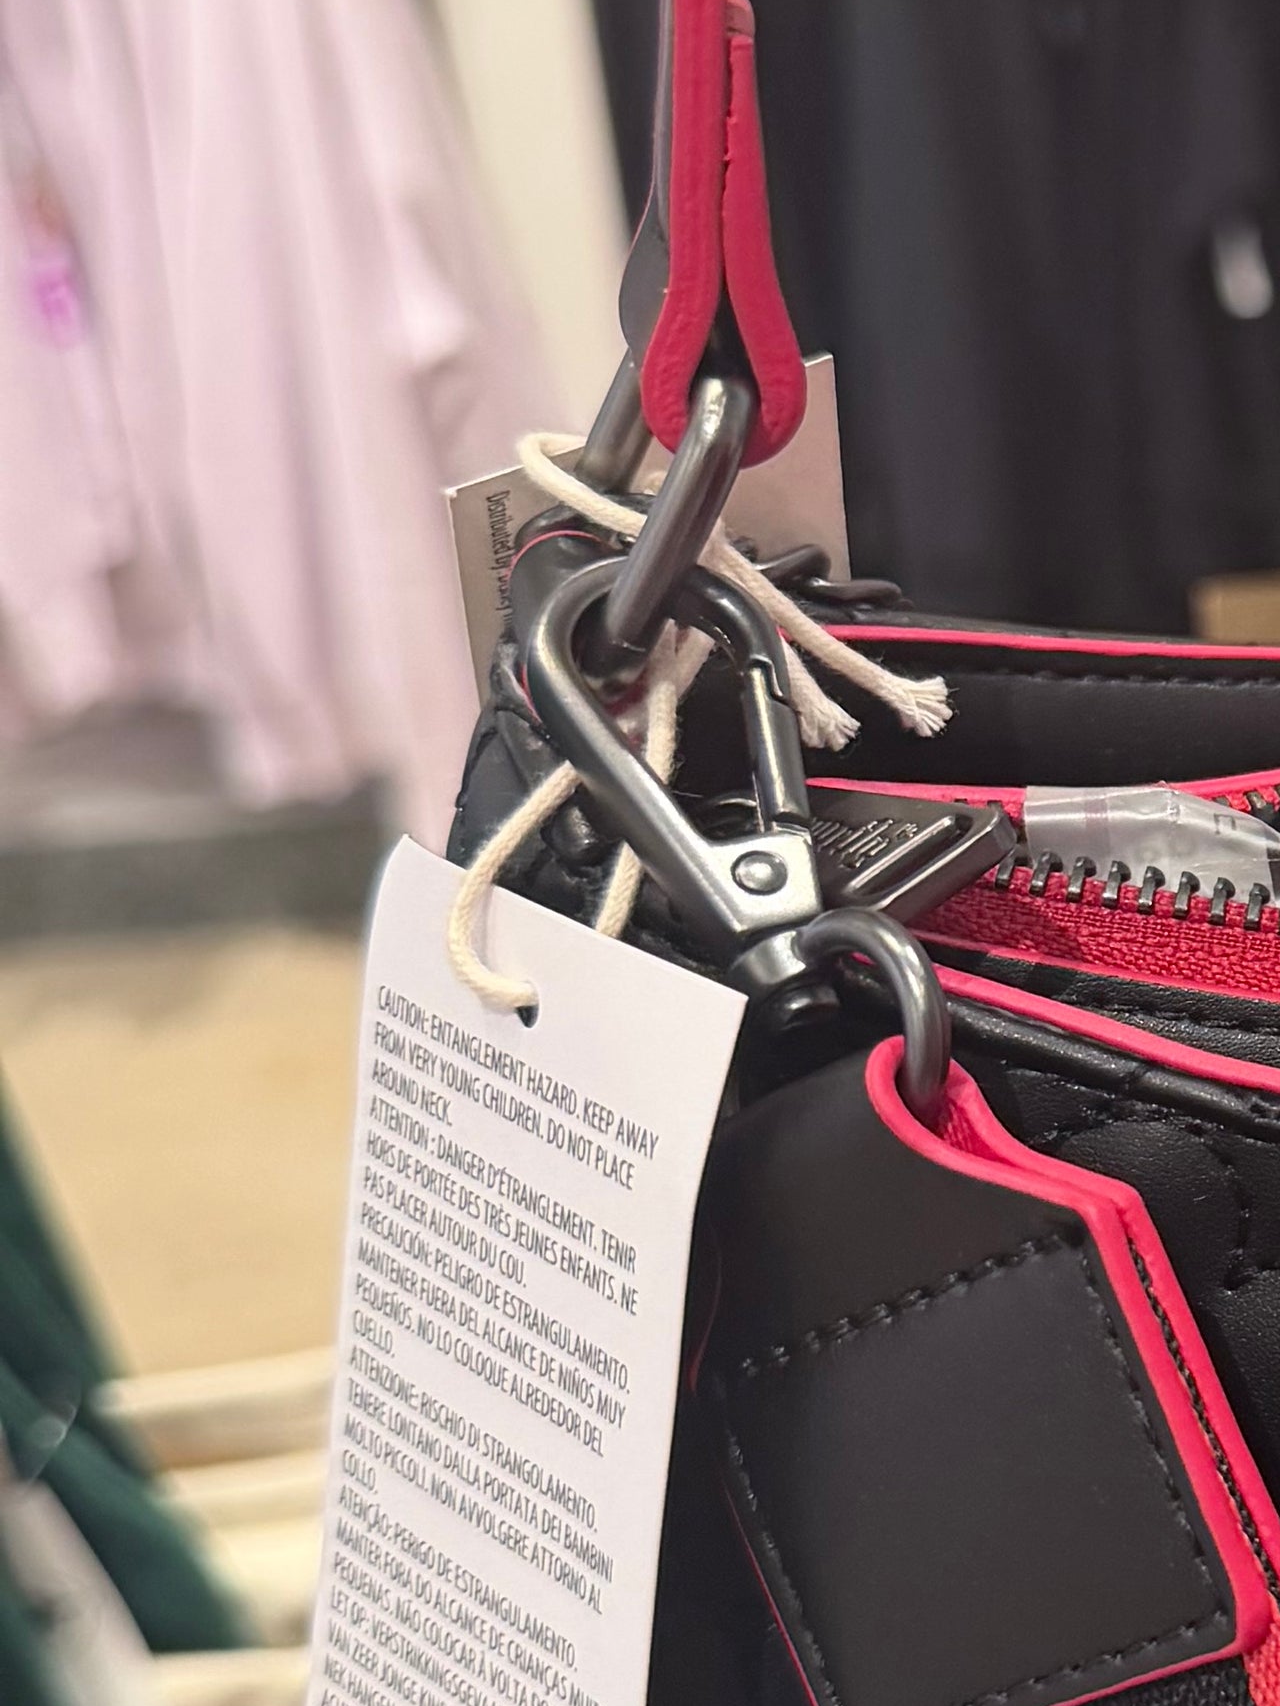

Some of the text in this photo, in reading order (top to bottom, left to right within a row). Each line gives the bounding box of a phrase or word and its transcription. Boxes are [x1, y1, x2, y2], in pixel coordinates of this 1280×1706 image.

[371, 1058, 452, 1126] AROUND NECK.
[374, 1021, 634, 1190] FROM VERY YOUNG CHILDREN. DO NOT PLACE
[377, 985, 658, 1159] CAUTION: ENTANGLEMENT HAZARD. KEEP AWAY
[363, 1165, 526, 1287] PAS PLACER AUTOUR DU COU.
[366, 1129, 395, 1168] HORS
[396, 1149, 412, 1179] DE
[457, 1185, 480, 1219] DES
[511, 1218, 557, 1265] JEUNES
[560, 1245, 616, 1303] ENFANTS.
[620, 1282, 638, 1315] NE
[369, 1094, 429, 1150] ATTENTION
[436, 1134, 485, 1183] DANGER
[601, 1228, 635, 1274] TENIR
[416, 1313, 434, 1344] NO
[435, 1325, 452, 1355] LO
[454, 1338, 508, 1392] COLOQUE
[509, 1373, 581, 1440] ALREDEDOR
[582, 1419, 603, 1457] DEL
[419, 1277, 456, 1321] FUERA
[458, 1301, 480, 1337] DEL
[481, 1317, 536, 1371] ALCANCE
[538, 1350, 555, 1383] DE
[595, 1389, 625, 1428] MUY
[434, 1247, 482, 1298] PELIGRO
[484, 1279, 500, 1310] DE
[502, 1289, 629, 1394] ESTRANGULAMIENTO.
[386, 1406, 612, 1582] LONTANO DALLA PORTATA DEI BAMBINI
[419, 1391, 465, 1440] RISCHIO
[467, 1422, 480, 1451] DI
[481, 1432, 597, 1532] STRANGOLAMENTO.
[382, 1551, 412, 1592] FORA
[414, 1573, 432, 1604] DO
[432, 1588, 487, 1644] ALCANCE
[488, 1625, 505, 1656] DE
[392, 1522, 435, 1569] PERIGO
[435, 1552, 452, 1583] DE
[430, 1473, 457, 1511] NON
[457, 1493, 529, 1560] AVVOLGERE
[529, 1541, 586, 1600] ATTORNO
[587, 1583, 602, 1614] AL
[422, 1617, 476, 1674] COLOCAR
